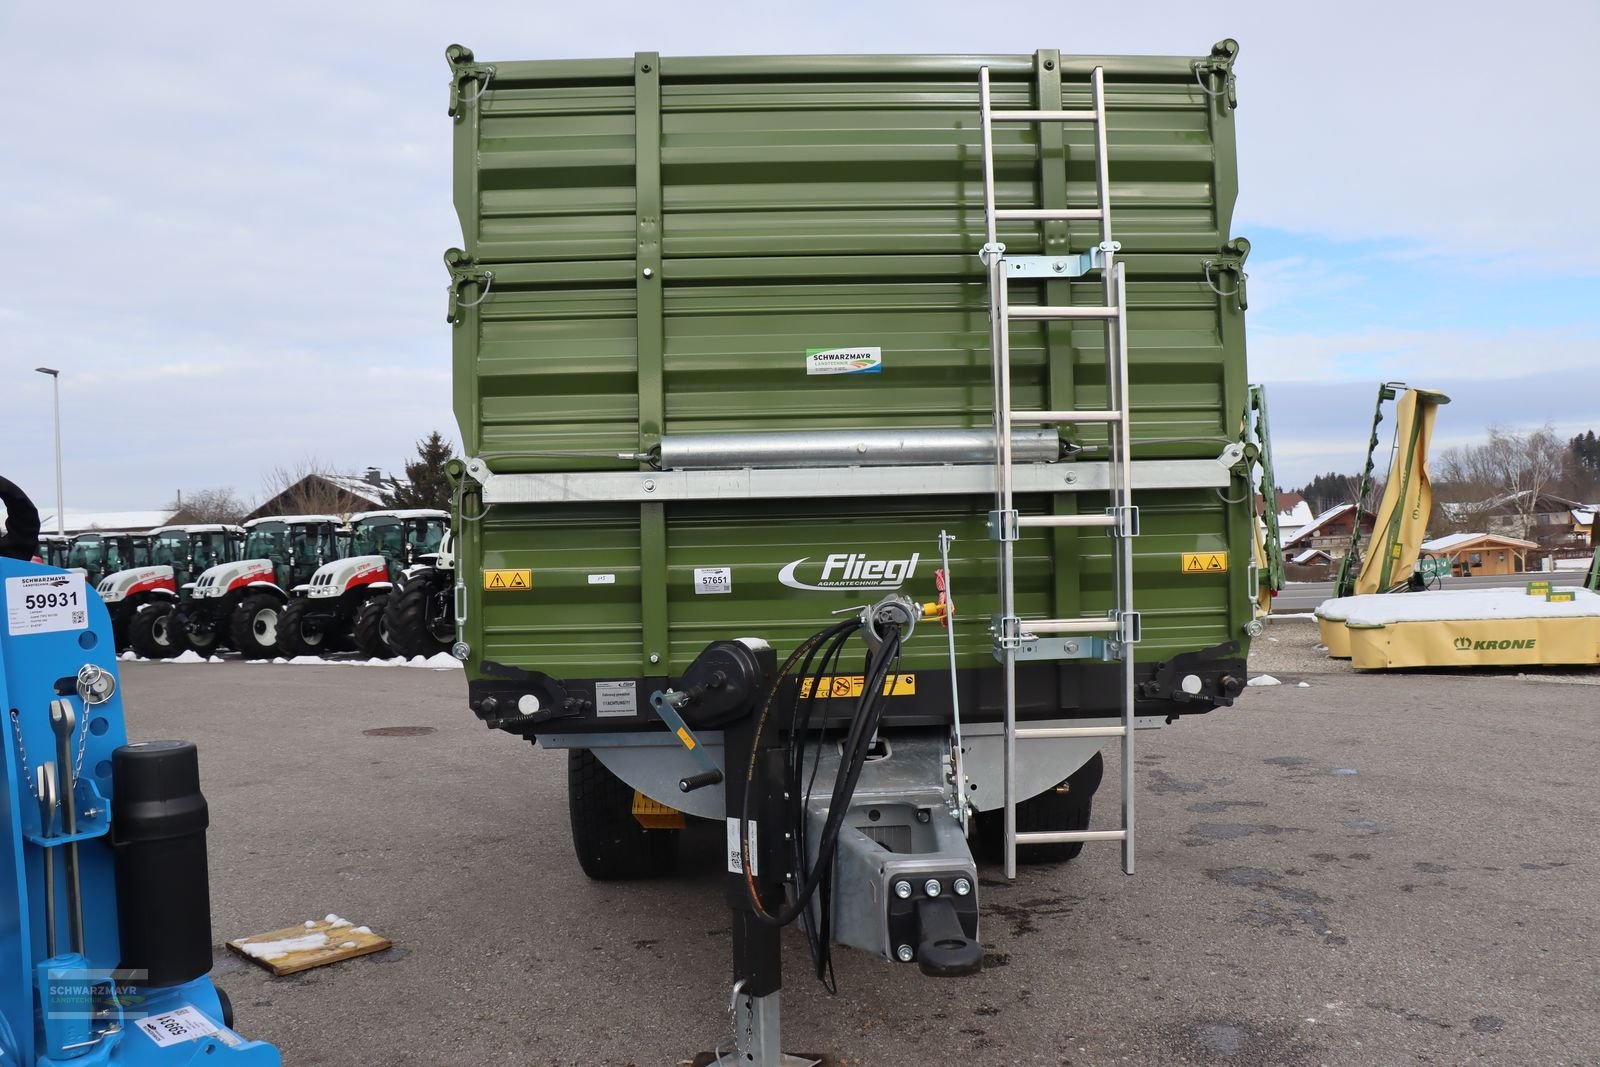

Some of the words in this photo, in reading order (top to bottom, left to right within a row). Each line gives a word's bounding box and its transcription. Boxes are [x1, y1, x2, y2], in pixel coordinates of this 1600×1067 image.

[813, 353, 871, 361] SCHWARZMAYR
[820, 552, 920, 585] Fliegl
[22, 576, 66, 584] SCHWARZMAYR
[702, 576, 727, 585] 57651
[26, 591, 77, 609] 59931
[1473, 639, 1537, 650] KRONE
[156, 1015, 188, 1036] 59931
